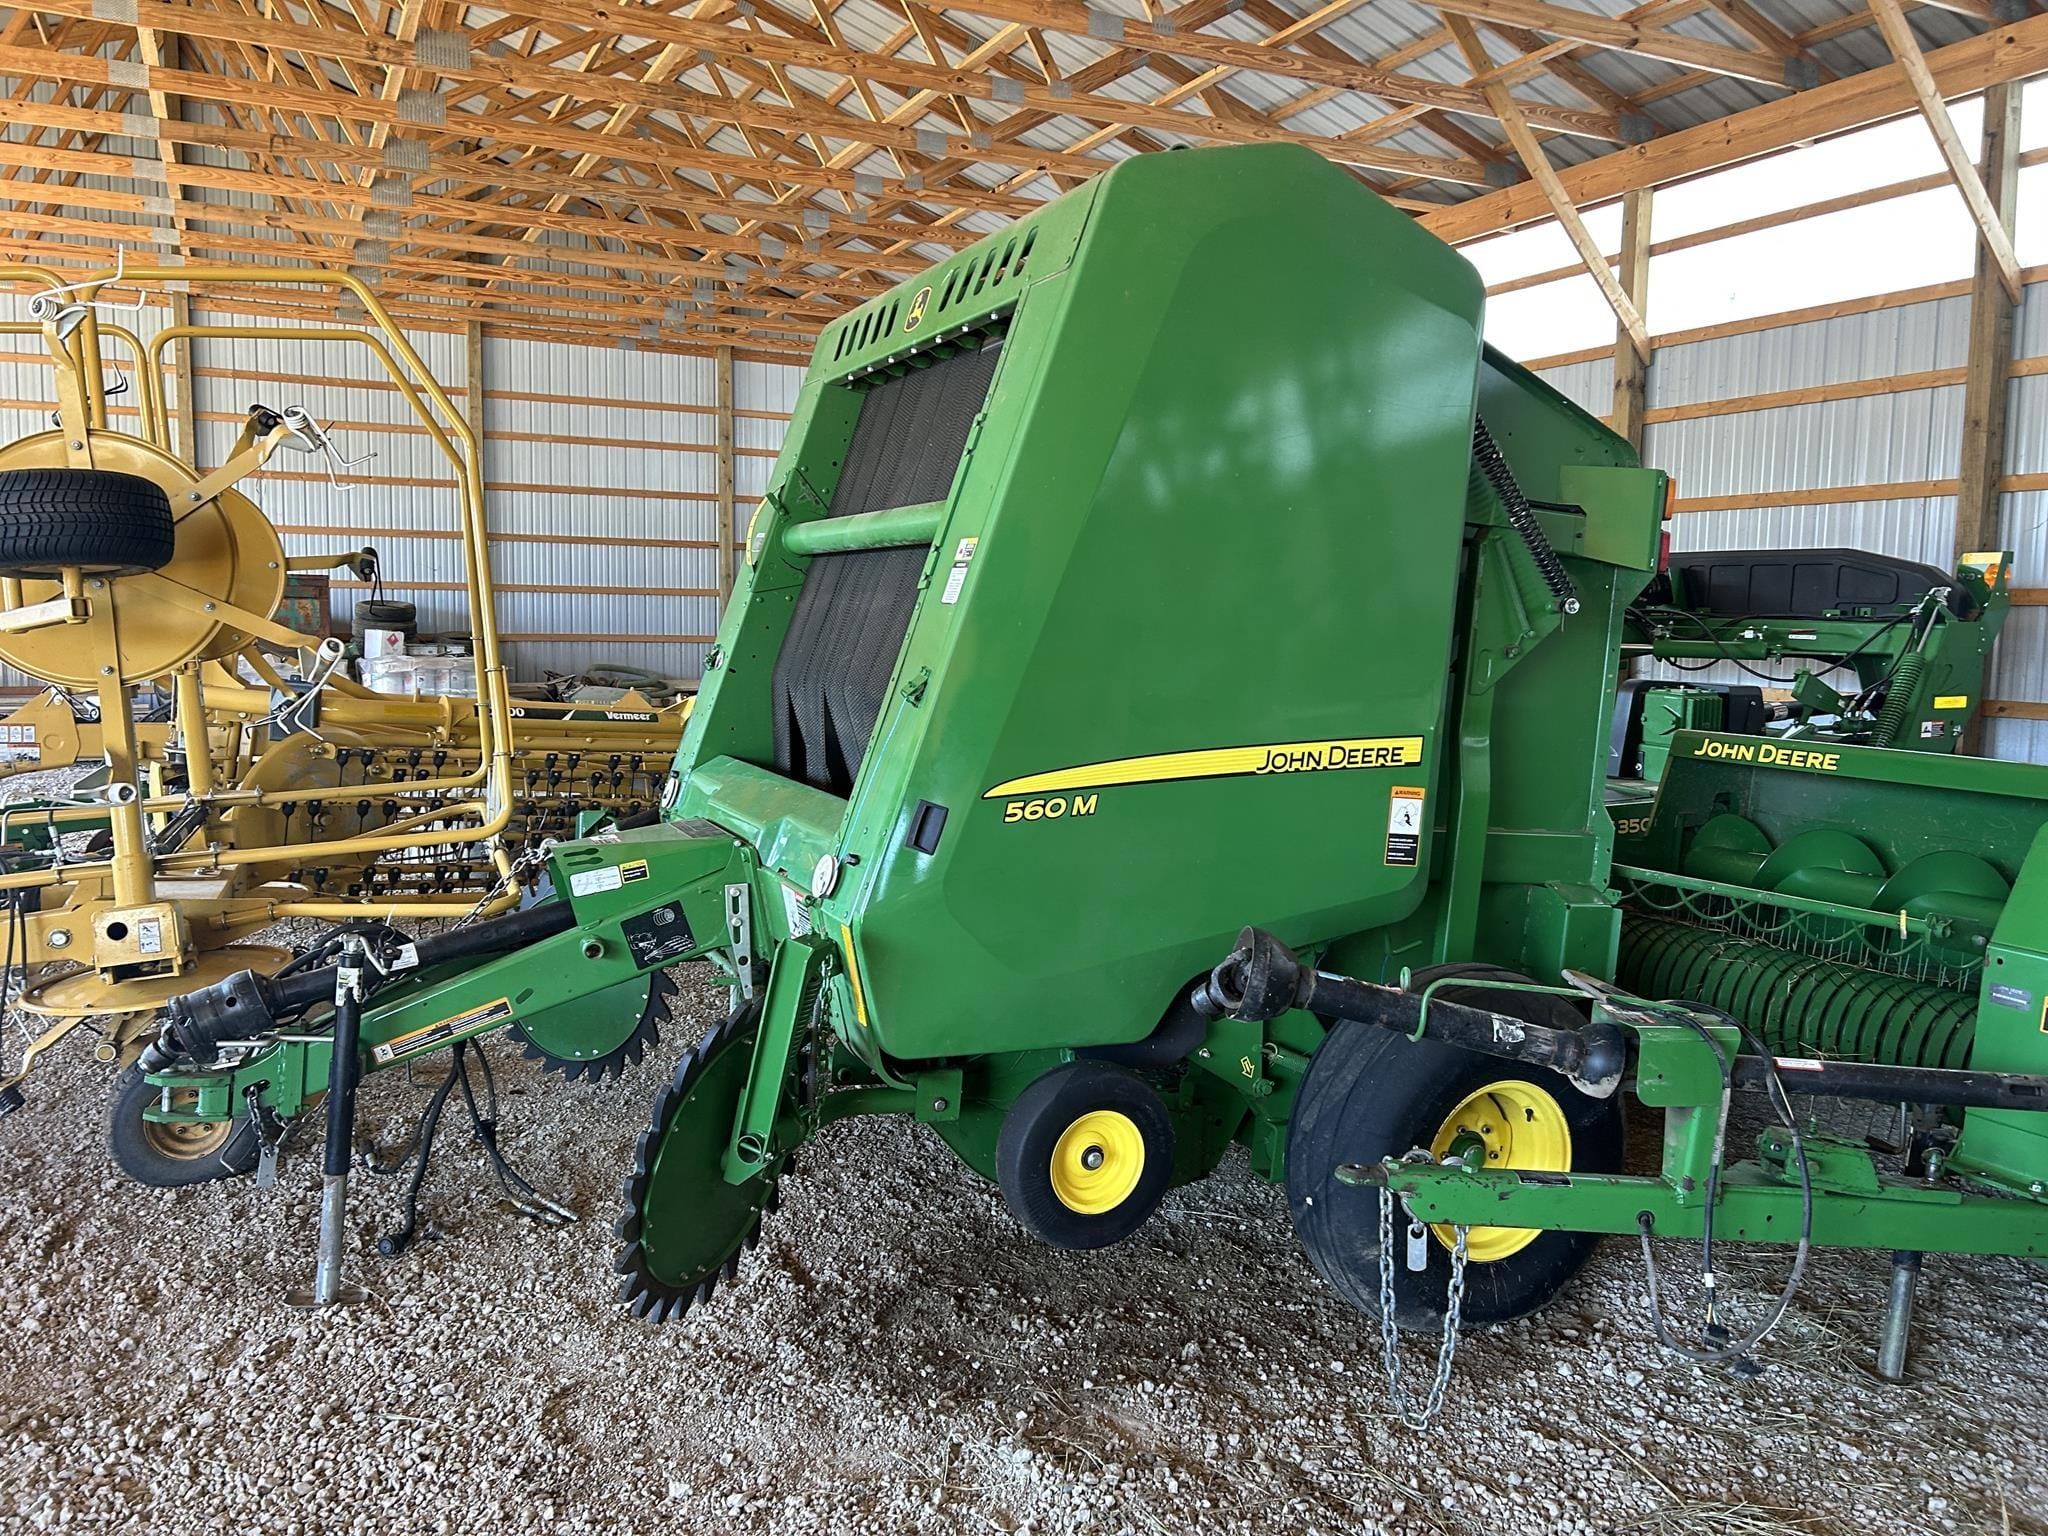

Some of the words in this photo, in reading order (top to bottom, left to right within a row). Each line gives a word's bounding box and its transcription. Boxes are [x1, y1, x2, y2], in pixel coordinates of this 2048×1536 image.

[605, 711, 651, 721] Vermeer
[1255, 749, 1323, 771] JOHN
[1328, 745, 1405, 766] DEERE
[1694, 738, 1754, 761] JOHN
[1757, 744, 1841, 771] DEERE
[1003, 797, 1068, 823] 560
[1071, 793, 1099, 817] M
